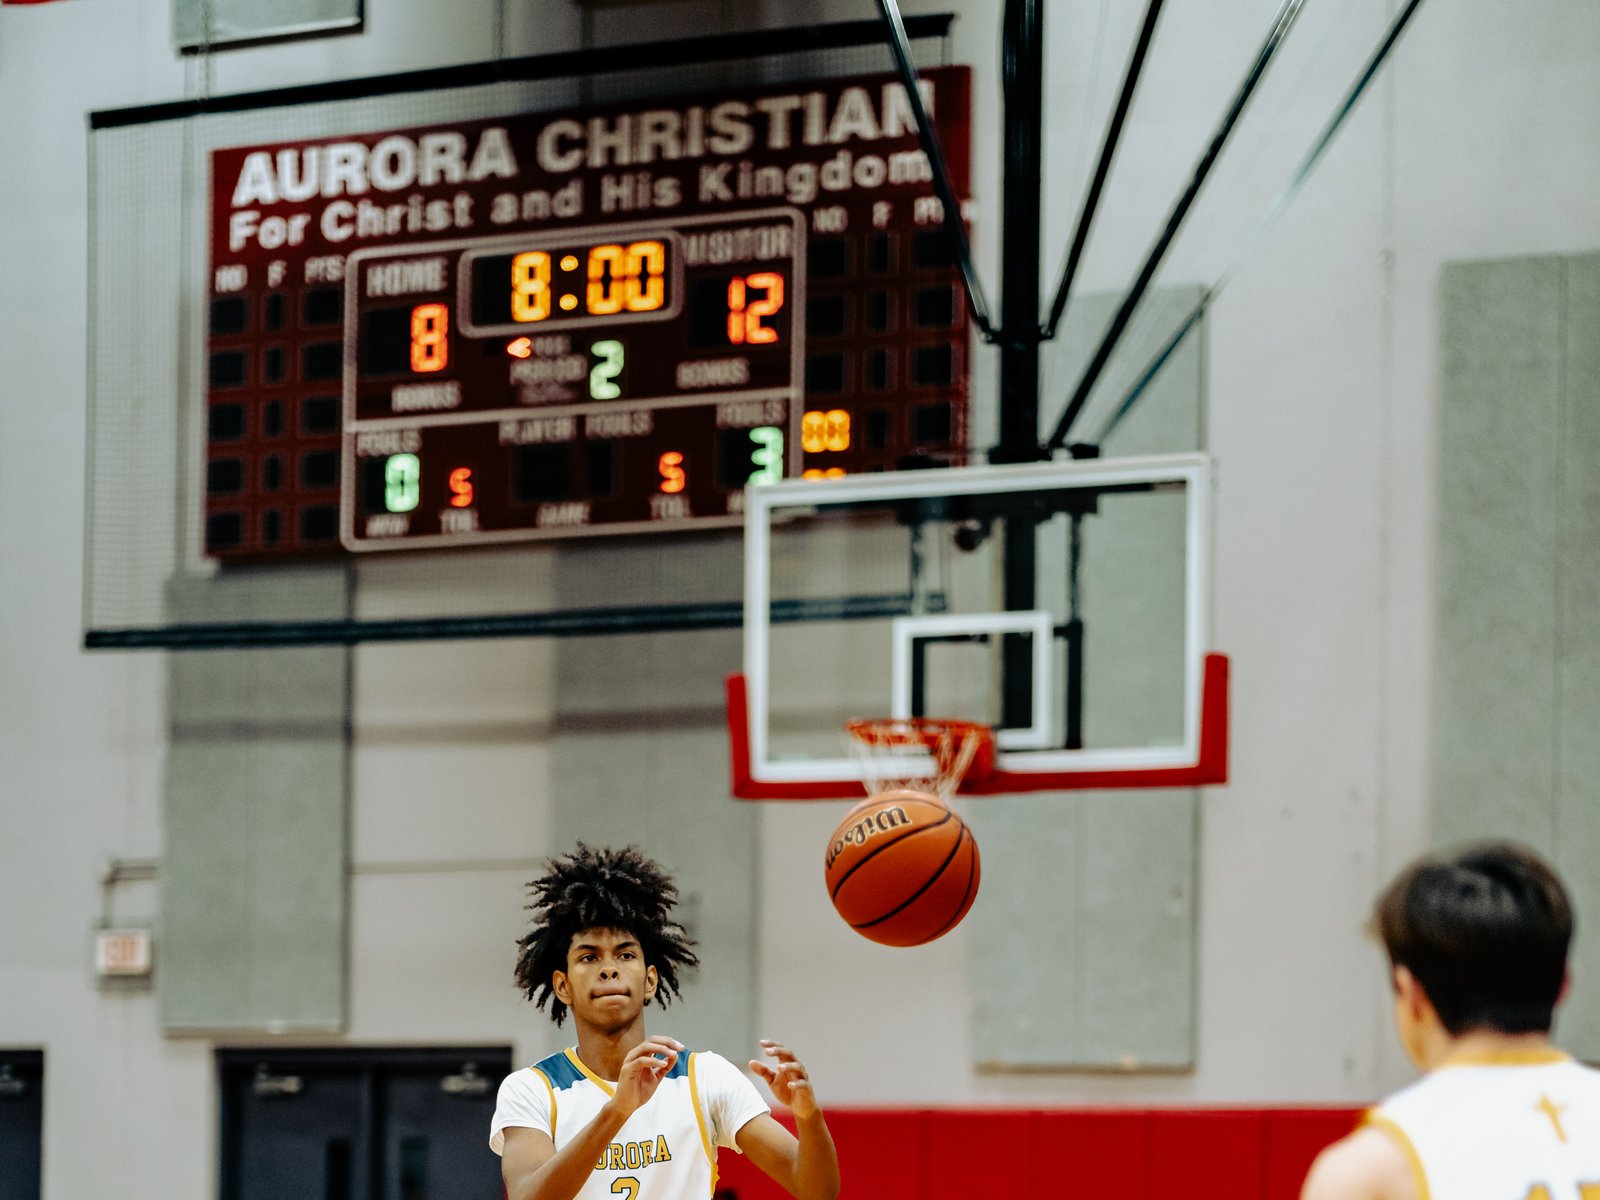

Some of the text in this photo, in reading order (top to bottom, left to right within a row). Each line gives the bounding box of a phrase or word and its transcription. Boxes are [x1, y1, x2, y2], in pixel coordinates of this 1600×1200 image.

[231, 79, 935, 208] AURORA CHRISTIAN
[229, 149, 934, 252] For Christ and His Kingdom
[366, 256, 449, 298] HOME
[511, 239, 665, 323] 8:00
[727, 272, 785, 345] 12
[410, 303, 449, 373] 8
[589, 339, 625, 400] 2
[747, 425, 784, 487] 3
[825, 805, 912, 871] Wilson
[594, 1134, 671, 1171] URORA
